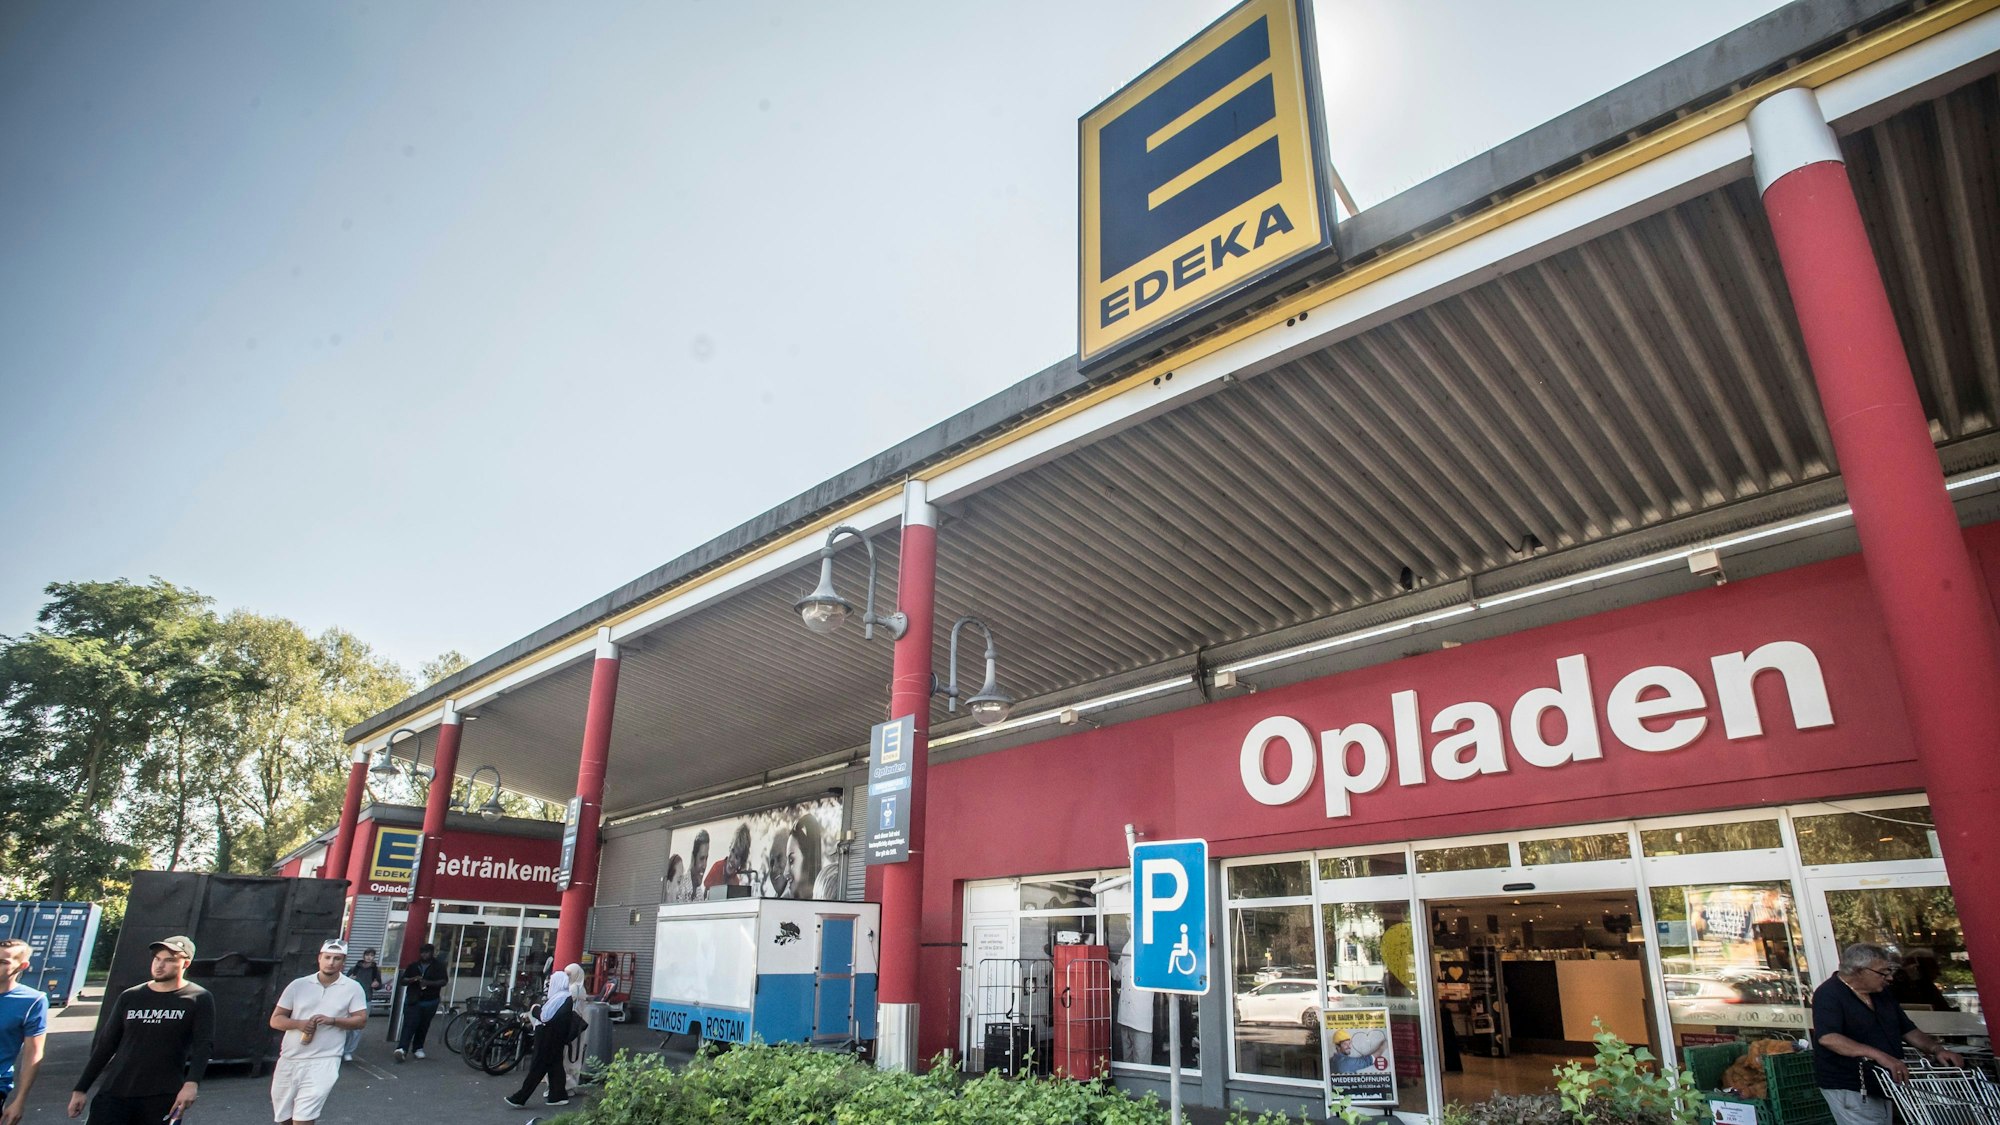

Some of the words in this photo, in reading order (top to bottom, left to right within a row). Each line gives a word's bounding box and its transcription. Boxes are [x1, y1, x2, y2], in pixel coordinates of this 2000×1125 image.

[1100, 203, 1295, 330] EDEKA
[1239, 640, 1834, 818] Opladen
[371, 883, 408, 893] Oplade
[1142, 858, 1189, 945] P
[127, 1009, 185, 1020] BALMAIN
[650, 1009, 687, 1032] FEINKOST
[706, 1016, 745, 1042] ROSTAM
[1771, 1013, 1804, 1023] 22.00
